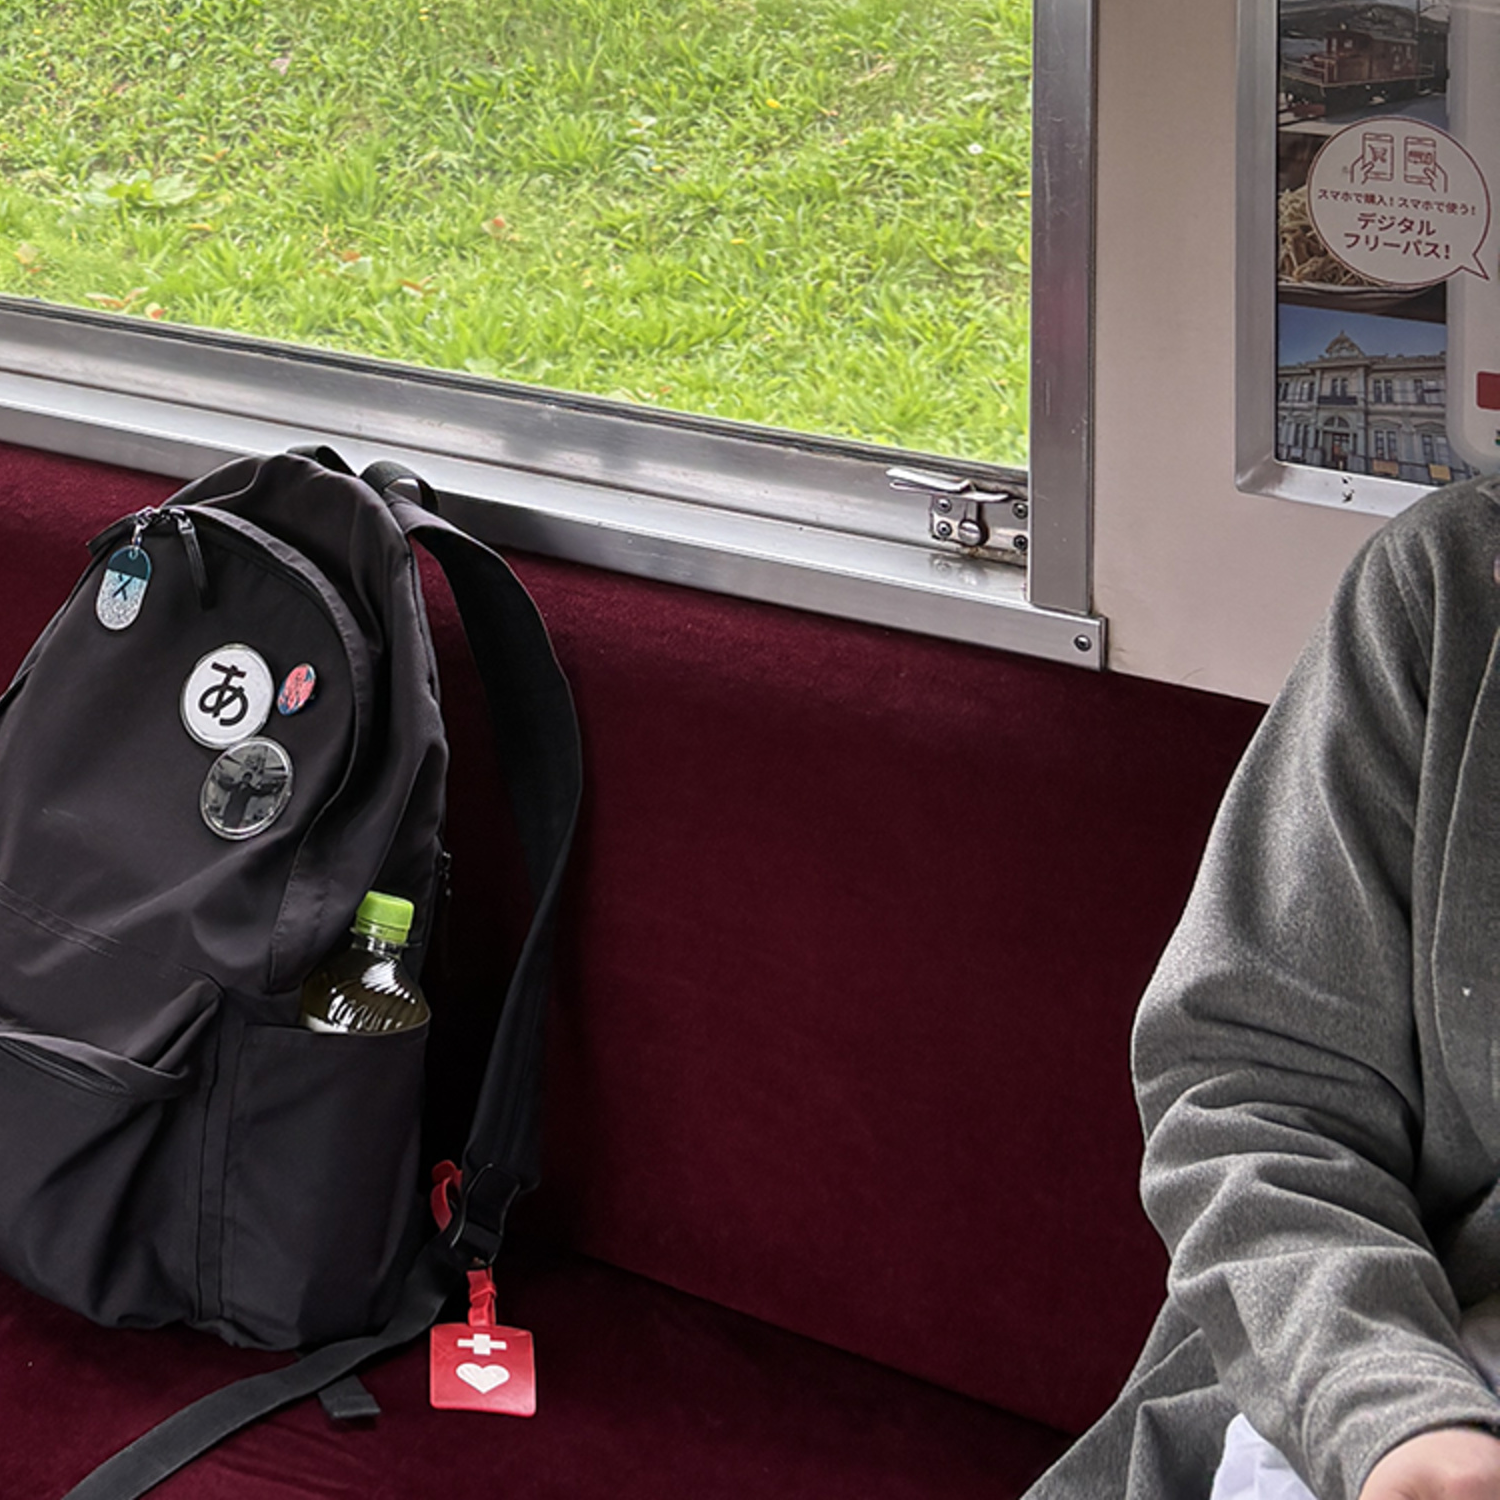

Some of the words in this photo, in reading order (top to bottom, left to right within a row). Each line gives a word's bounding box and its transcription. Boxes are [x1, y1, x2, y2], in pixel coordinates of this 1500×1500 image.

[1357, 213, 1436, 236] デジタル
[198, 662, 249, 726] あ
